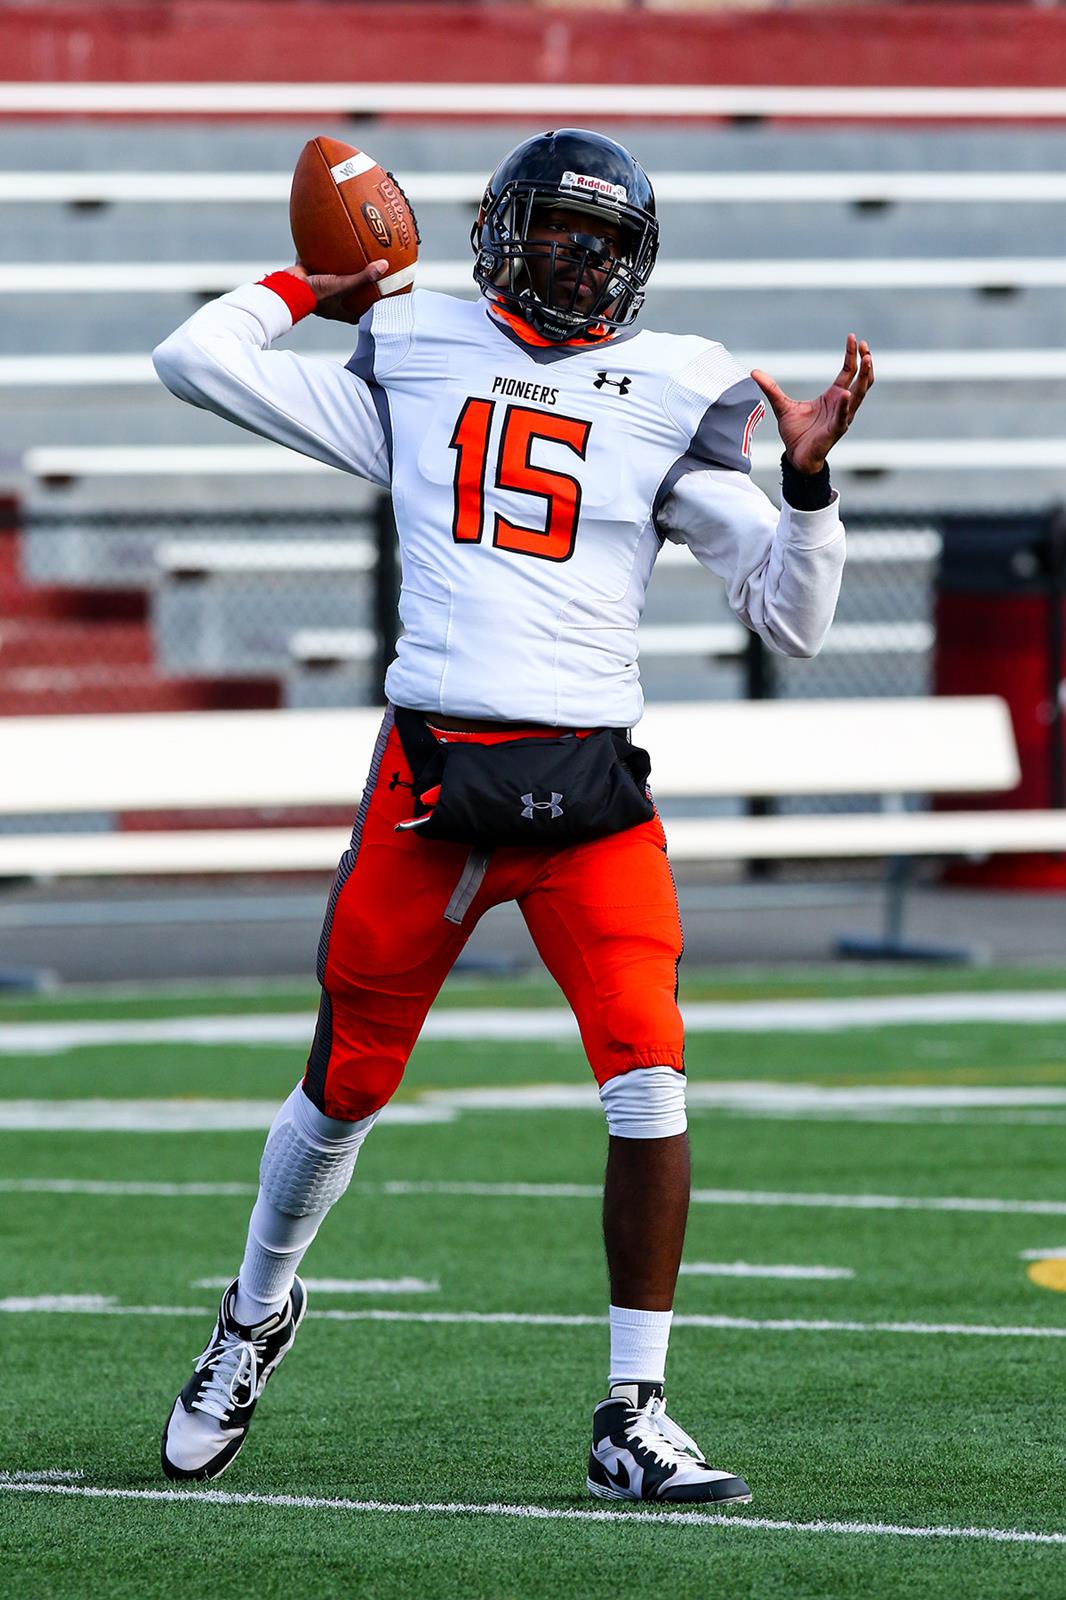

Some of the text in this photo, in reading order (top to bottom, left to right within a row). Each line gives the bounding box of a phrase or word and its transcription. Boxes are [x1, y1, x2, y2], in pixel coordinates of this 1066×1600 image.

[577, 176, 612, 193] Riddell
[366, 206, 390, 244] GST
[380, 180, 411, 248] Wilson
[491, 376, 560, 406] PIONEERS
[448, 396, 593, 563] 15
